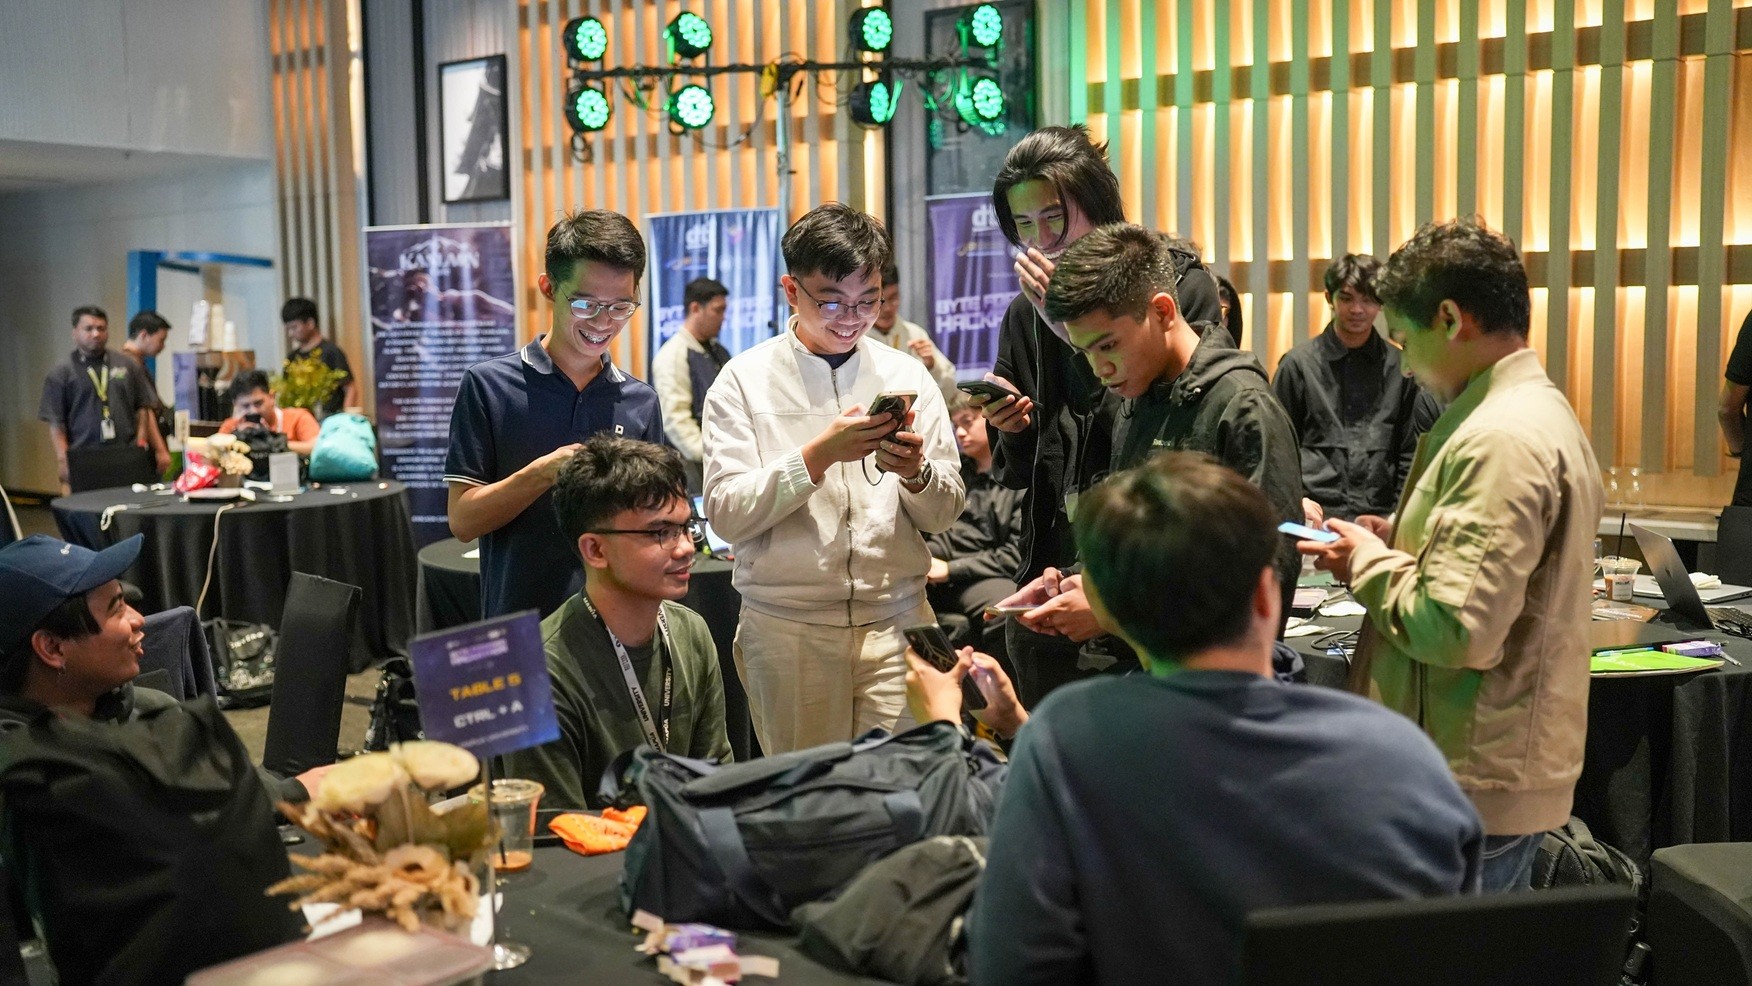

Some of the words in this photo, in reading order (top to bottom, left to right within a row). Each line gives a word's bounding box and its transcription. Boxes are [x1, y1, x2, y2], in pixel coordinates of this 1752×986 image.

[449, 676, 506, 701] TABLE
[663, 666, 672, 707] UNIVERSITY
[453, 708, 497, 729] CTRL
[510, 700, 524, 714] A
